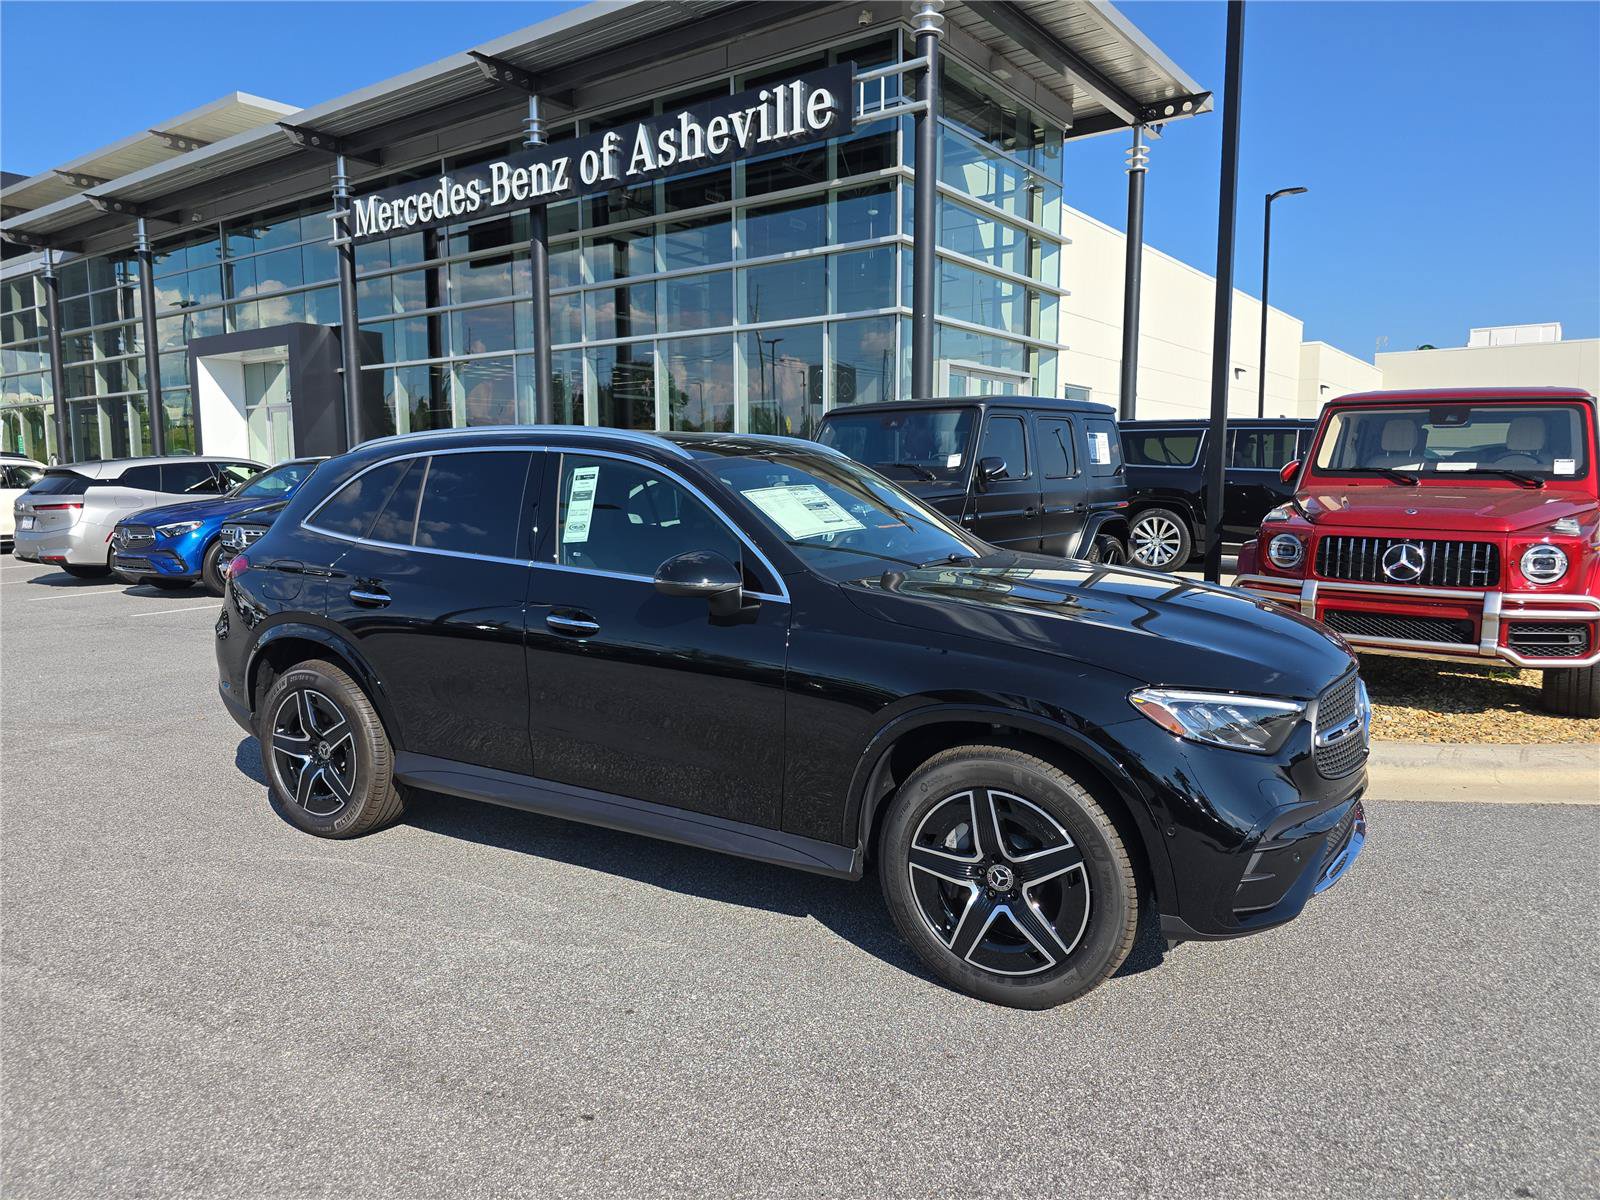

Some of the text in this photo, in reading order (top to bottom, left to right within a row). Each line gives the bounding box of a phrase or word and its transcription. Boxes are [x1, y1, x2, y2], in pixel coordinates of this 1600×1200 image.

[353, 80, 836, 238] Mercedes-Benz of Asheville
